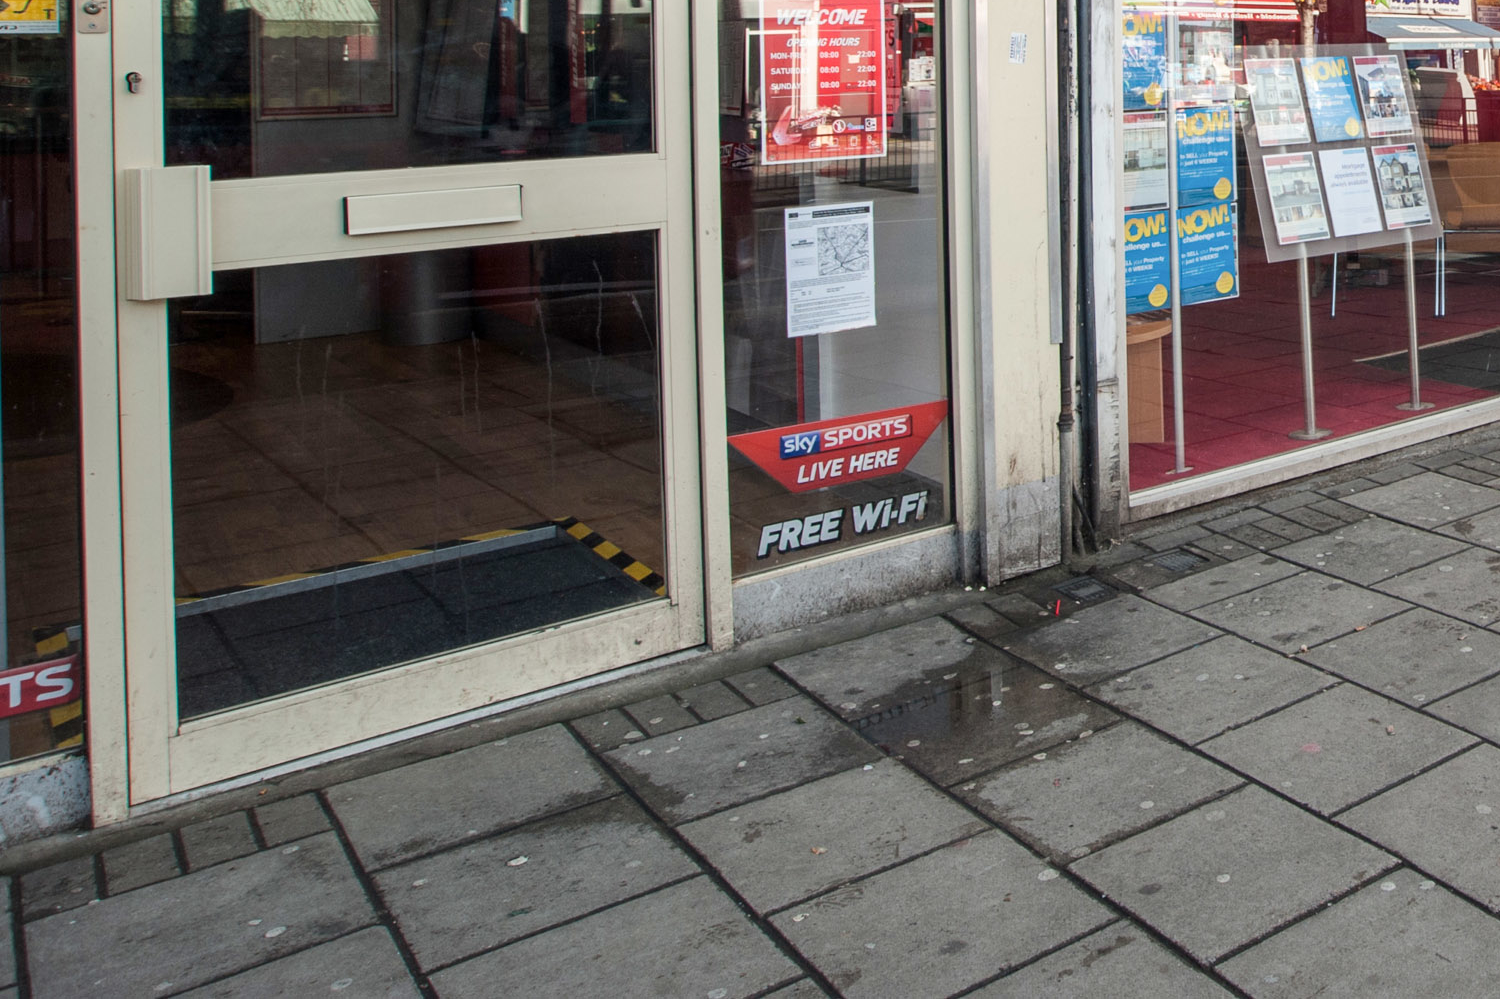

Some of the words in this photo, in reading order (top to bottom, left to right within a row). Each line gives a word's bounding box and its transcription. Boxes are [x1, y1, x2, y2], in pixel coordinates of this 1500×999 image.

[776, 8, 868, 26] WELCOME
[1122, 14, 1163, 36] OW!
[829, 37, 861, 46] HOURS
[819, 51, 839, 59] 08:00
[819, 66, 840, 74] 08:00
[856, 65, 877, 73] 22:00
[1303, 58, 1349, 82] NOW!
[820, 81, 840, 89] 08:00
[857, 80, 877, 88] 22:00
[1178, 109, 1231, 139] NOW!
[1125, 212, 1165, 238] OW!
[1178, 203, 1231, 238] NOW!
[1125, 242, 1150, 251] allenge
[1182, 233, 1216, 244] challenge
[783, 432, 819, 454] sky
[823, 418, 908, 448] SPORTS
[797, 458, 845, 484] LIVE
[849, 447, 900, 474] HERE
[757, 508, 844, 558] FREE
